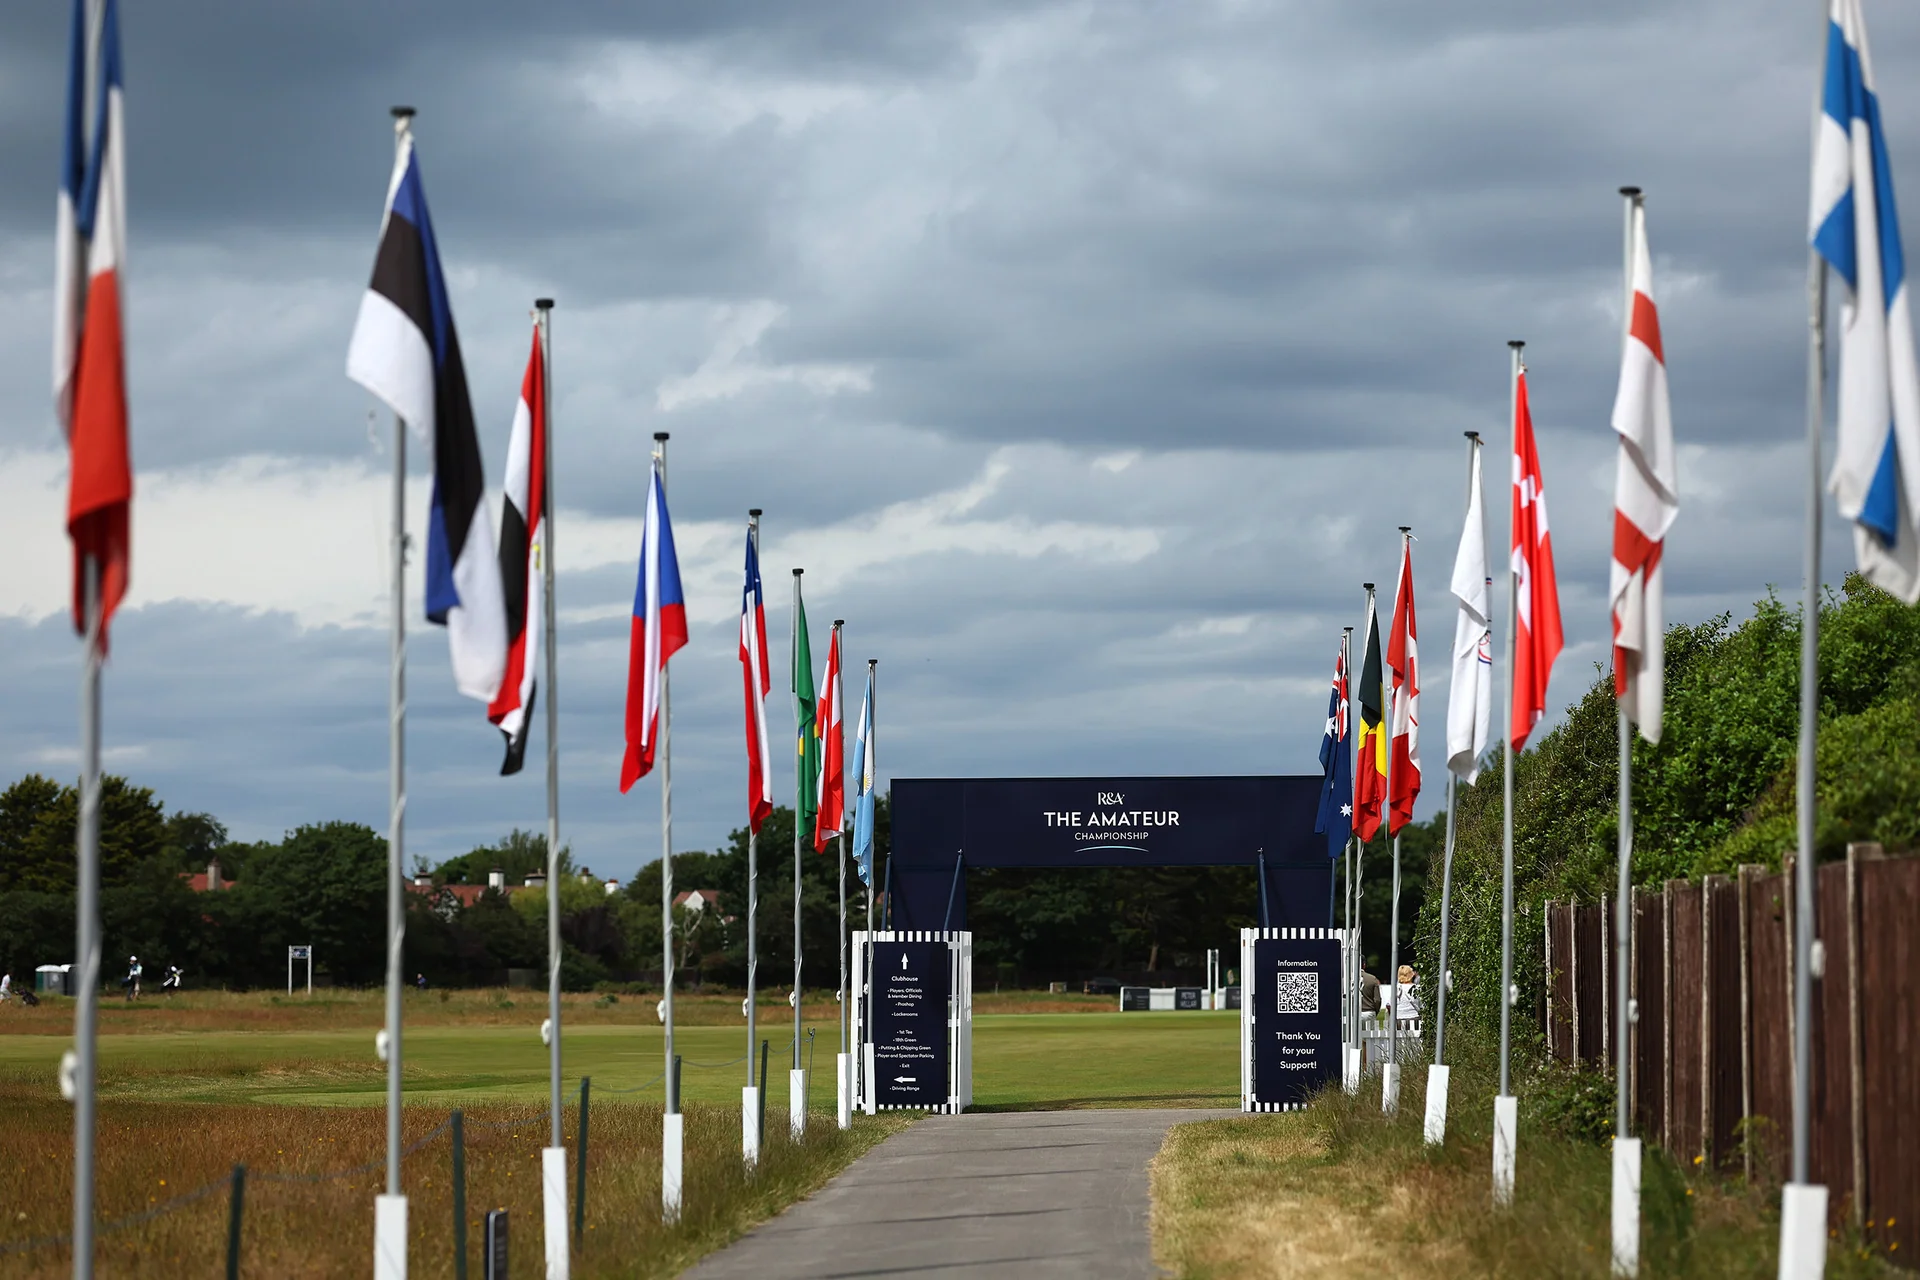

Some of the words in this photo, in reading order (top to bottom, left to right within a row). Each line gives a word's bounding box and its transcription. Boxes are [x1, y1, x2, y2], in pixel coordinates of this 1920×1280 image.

[1098, 792, 1125, 805] R&A
[1044, 812, 1082, 826] THE
[1087, 811, 1180, 826] AMATEUR
[1074, 832, 1149, 840] CHAMPIONSHIP
[1276, 1032, 1303, 1040] Thank
[1304, 1032, 1321, 1040] You
[1296, 1048, 1314, 1057] your
[1280, 1061, 1317, 1071] Support!
